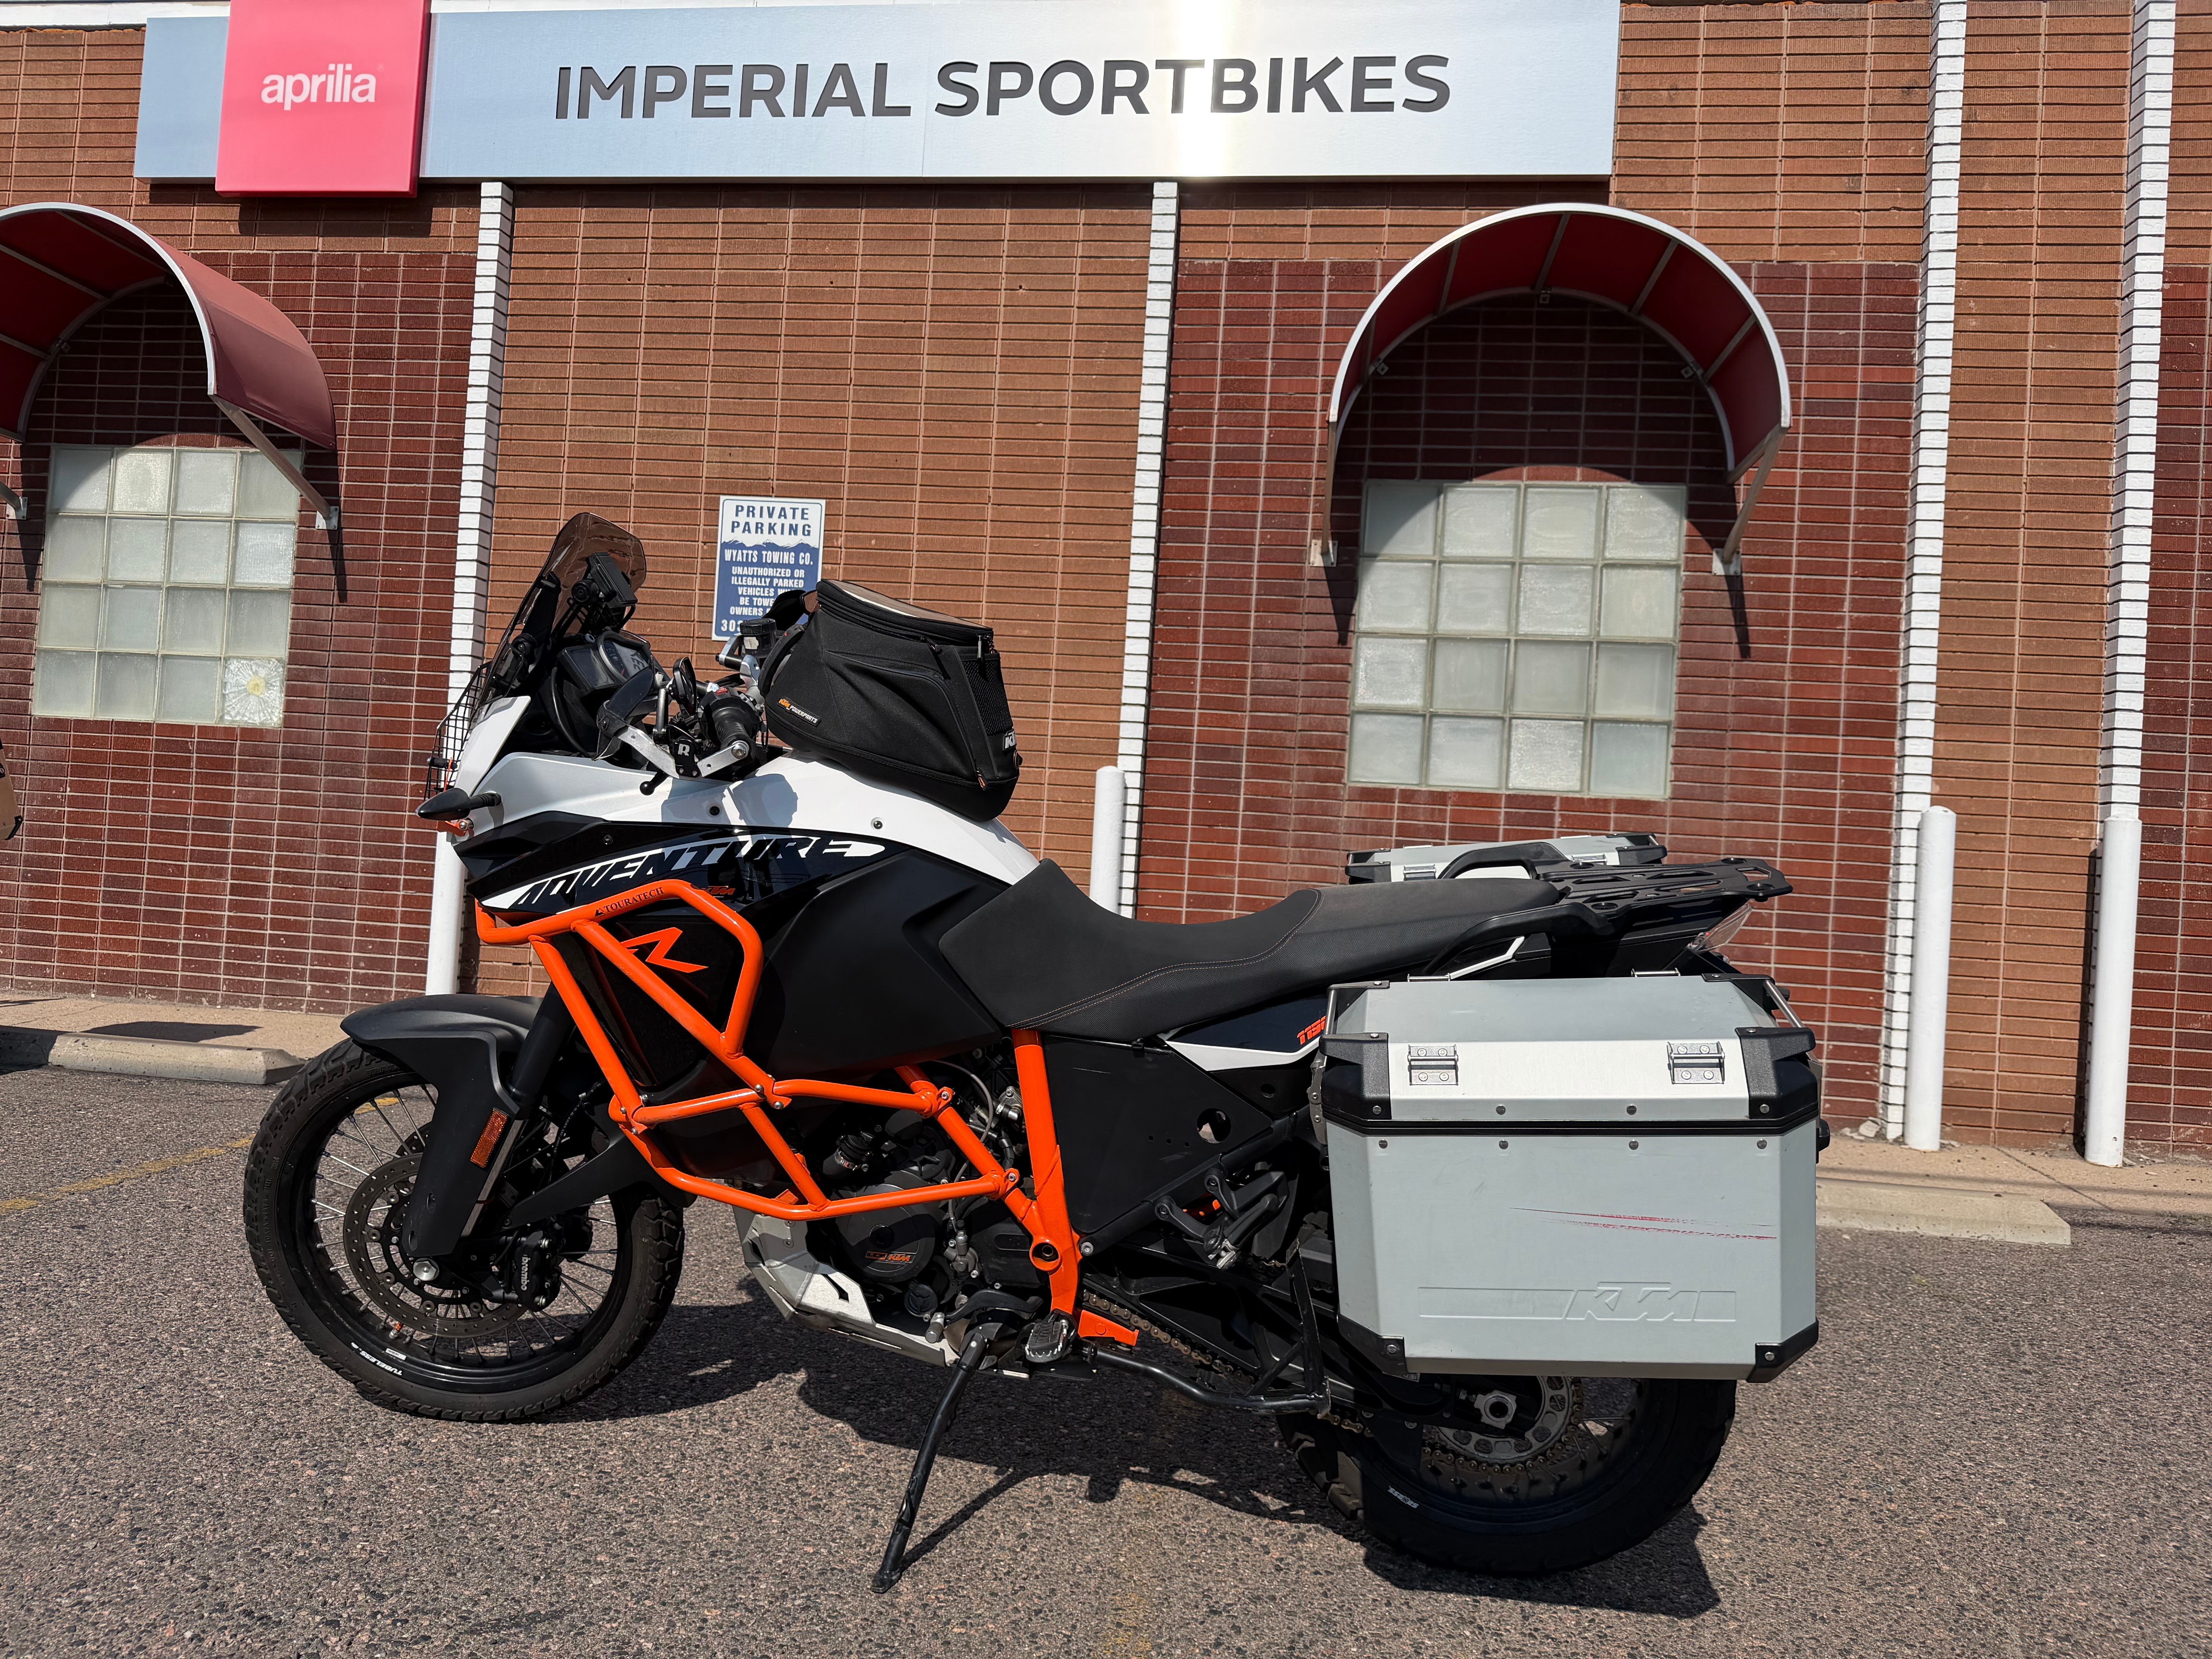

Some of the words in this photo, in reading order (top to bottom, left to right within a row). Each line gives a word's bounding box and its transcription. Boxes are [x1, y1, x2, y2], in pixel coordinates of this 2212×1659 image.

[261, 64, 376, 110] aprilia
[555, 63, 912, 119] IMPERIAL
[934, 54, 1451, 117] SPORTBIKES
[735, 505, 809, 520] PRIVATE
[731, 520, 811, 537] PARKING
[725, 549, 758, 562] WYATTS
[762, 551, 795, 564] TOWING
[799, 552, 813, 565] CO.
[732, 567, 791, 577] UNAUTHORIZED
[794, 569, 805, 578] OR
[732, 576, 771, 586] ILLEGALLY
[773, 579, 804, 588] PARKED
[738, 587, 775, 596] VEHICLES
[739, 597, 749, 605] BE
[752, 597, 776, 606] TOWE
[730, 606, 763, 616] OWNERS
[790, 705, 818, 723] POWERPARTS
[1005, 731, 1016, 749] KT
[678, 744, 690, 756] R
[503, 835, 858, 910] ADVENTURE
[706, 886, 735, 895] KTM
[604, 887, 665, 913] TOURATECH
[888, 1253, 911, 1262] KTM
[521, 1255, 531, 1291] brembo
[1566, 1282, 1698, 1321] KTM
[359, 1350, 402, 1376] TUBELESS
